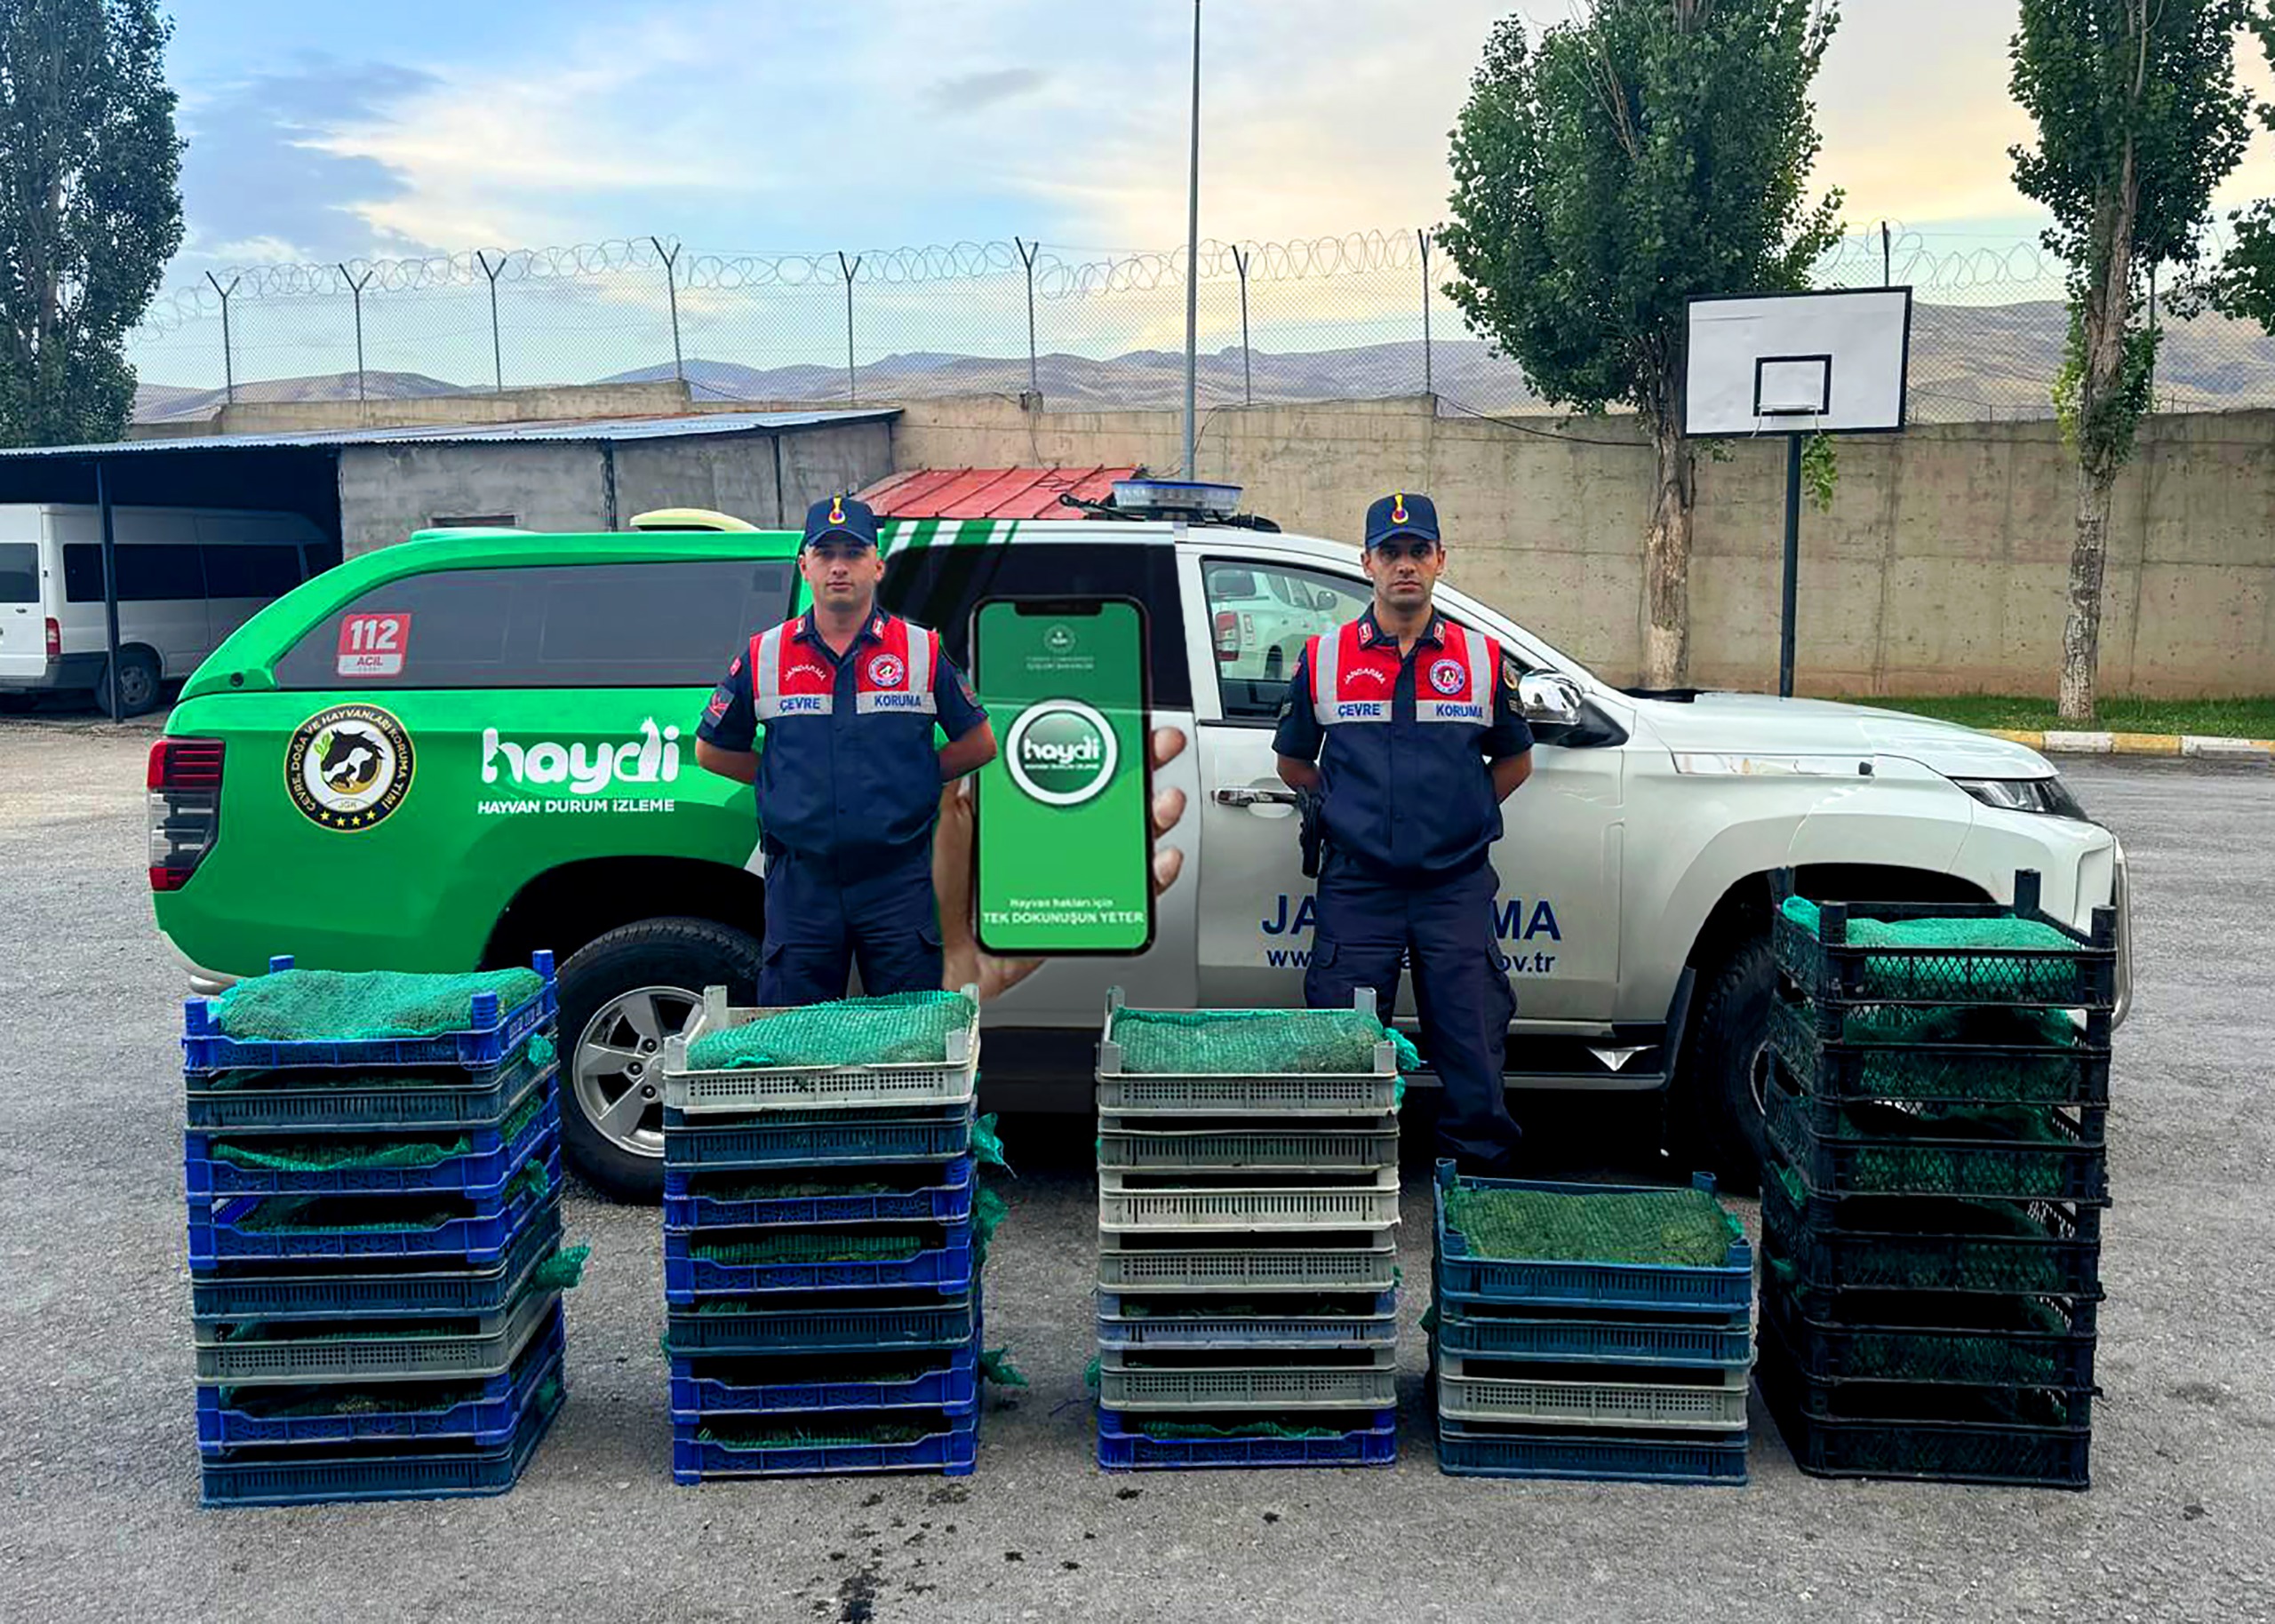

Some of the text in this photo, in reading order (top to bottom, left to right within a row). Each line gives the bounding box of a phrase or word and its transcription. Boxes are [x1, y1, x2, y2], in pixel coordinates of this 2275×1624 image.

[350, 617, 399, 650] 112
[1345, 667, 1386, 685] JANDARMA
[780, 695, 922, 712] ÇEVRE KORUMA
[1337, 703, 1483, 719] ÇEVRE KORUMA
[305, 720, 321, 735] VE
[322, 709, 392, 731] HAYVANLARI
[388, 728, 409, 778] KORUMA
[481, 716, 680, 794] haydi
[1024, 736, 1100, 764] haydi
[477, 798, 675, 814] HAYVAN DURUM İZLEME
[983, 912, 1145, 925] TEK DOKUNUŞUN YETER
[1262, 894, 1561, 942] JAMA
